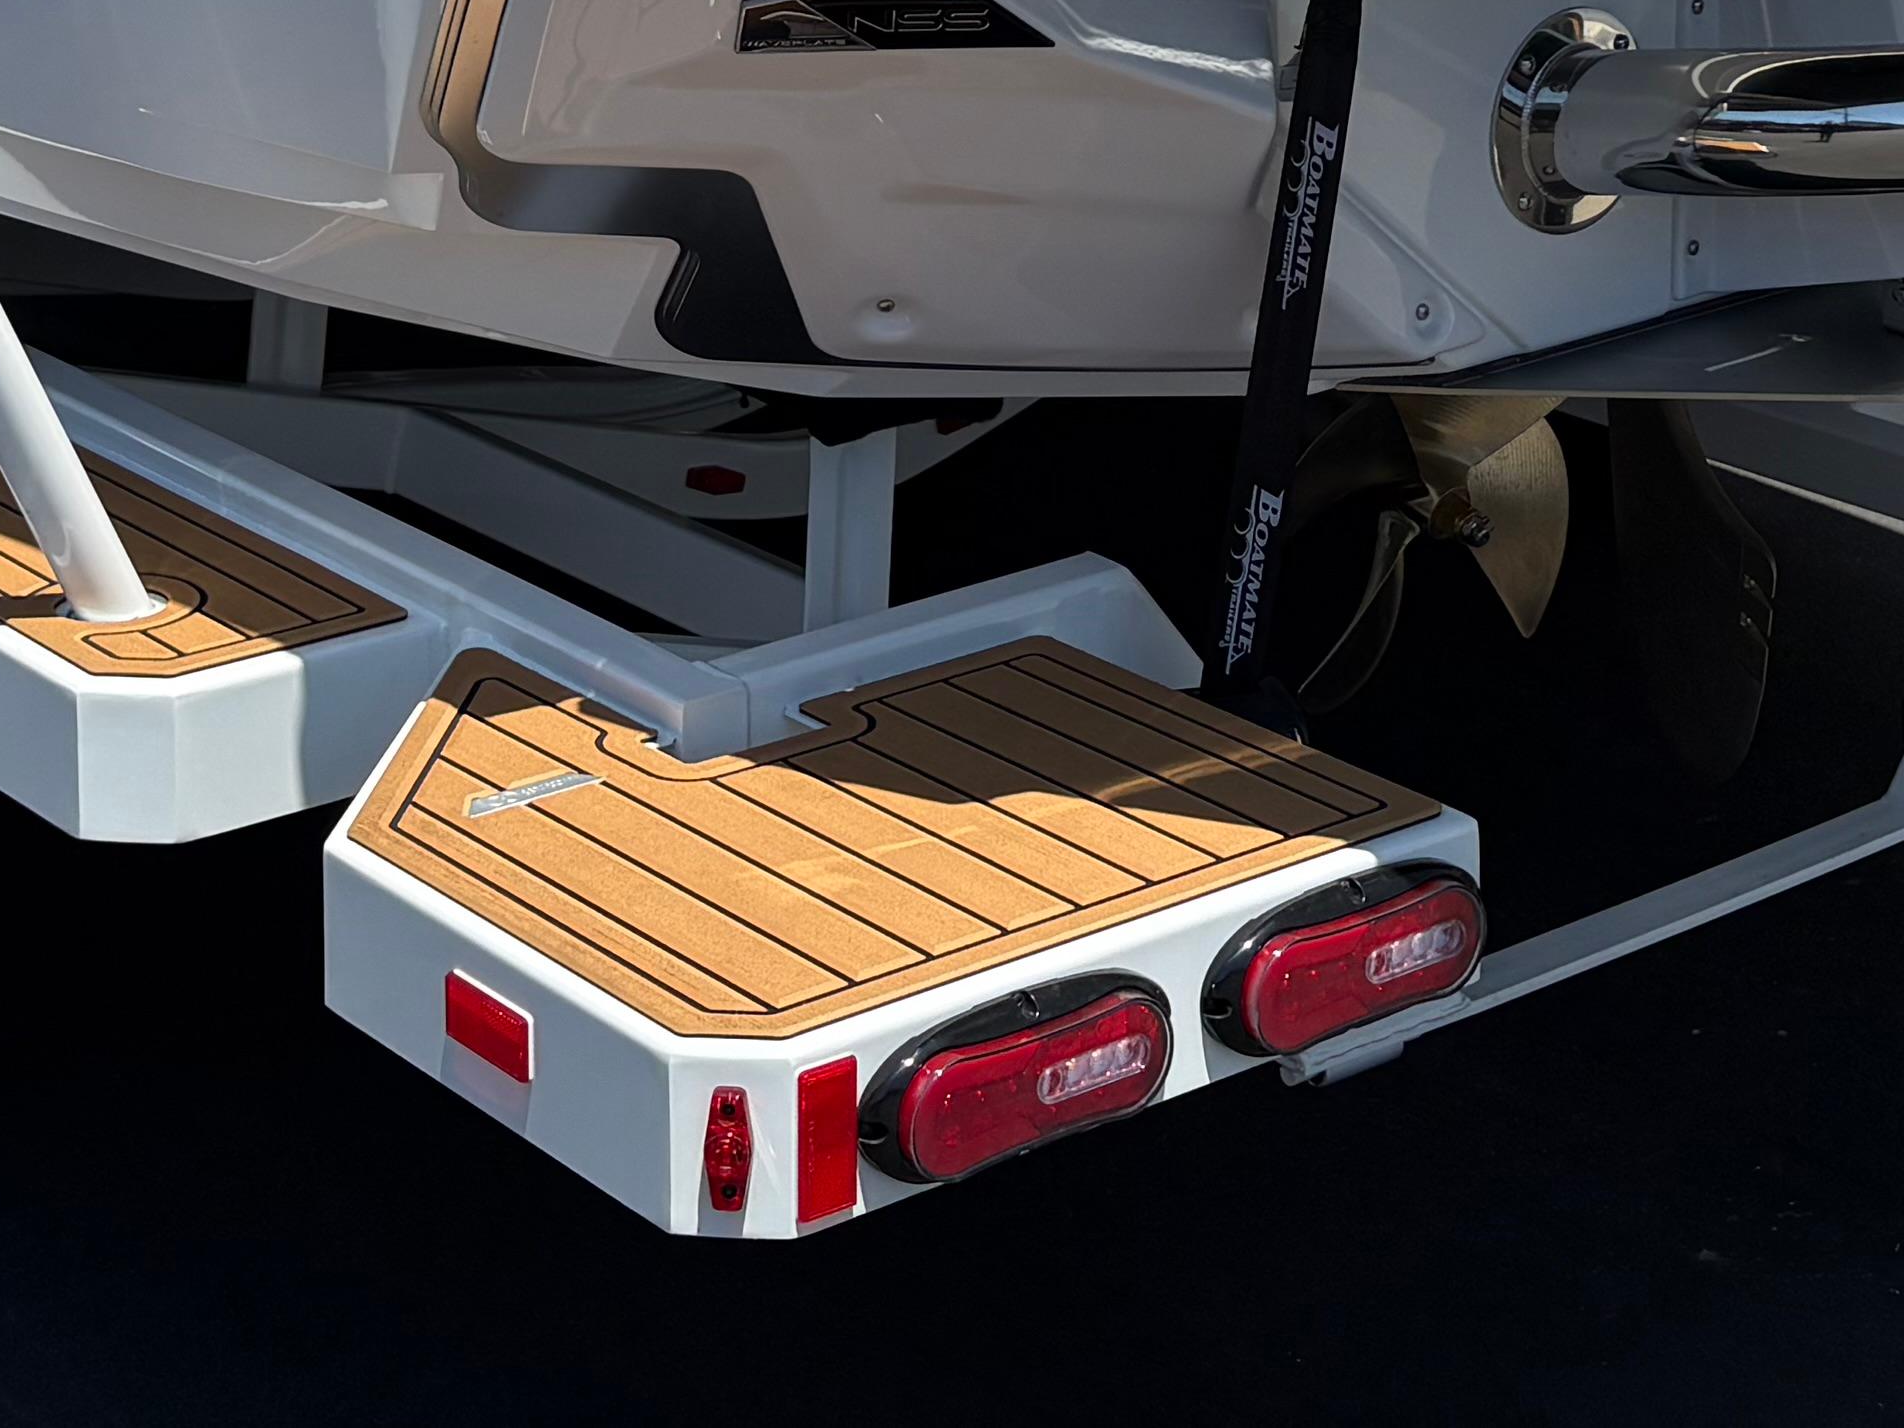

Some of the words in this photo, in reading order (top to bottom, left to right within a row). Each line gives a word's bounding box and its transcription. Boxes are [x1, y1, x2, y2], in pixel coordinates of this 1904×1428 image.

[846, 8, 990, 33] NSS
[1294, 120, 1341, 289] BOATMATE
[1224, 587, 1238, 642] TRAILERS
[1238, 486, 1286, 654] BOATMATE
